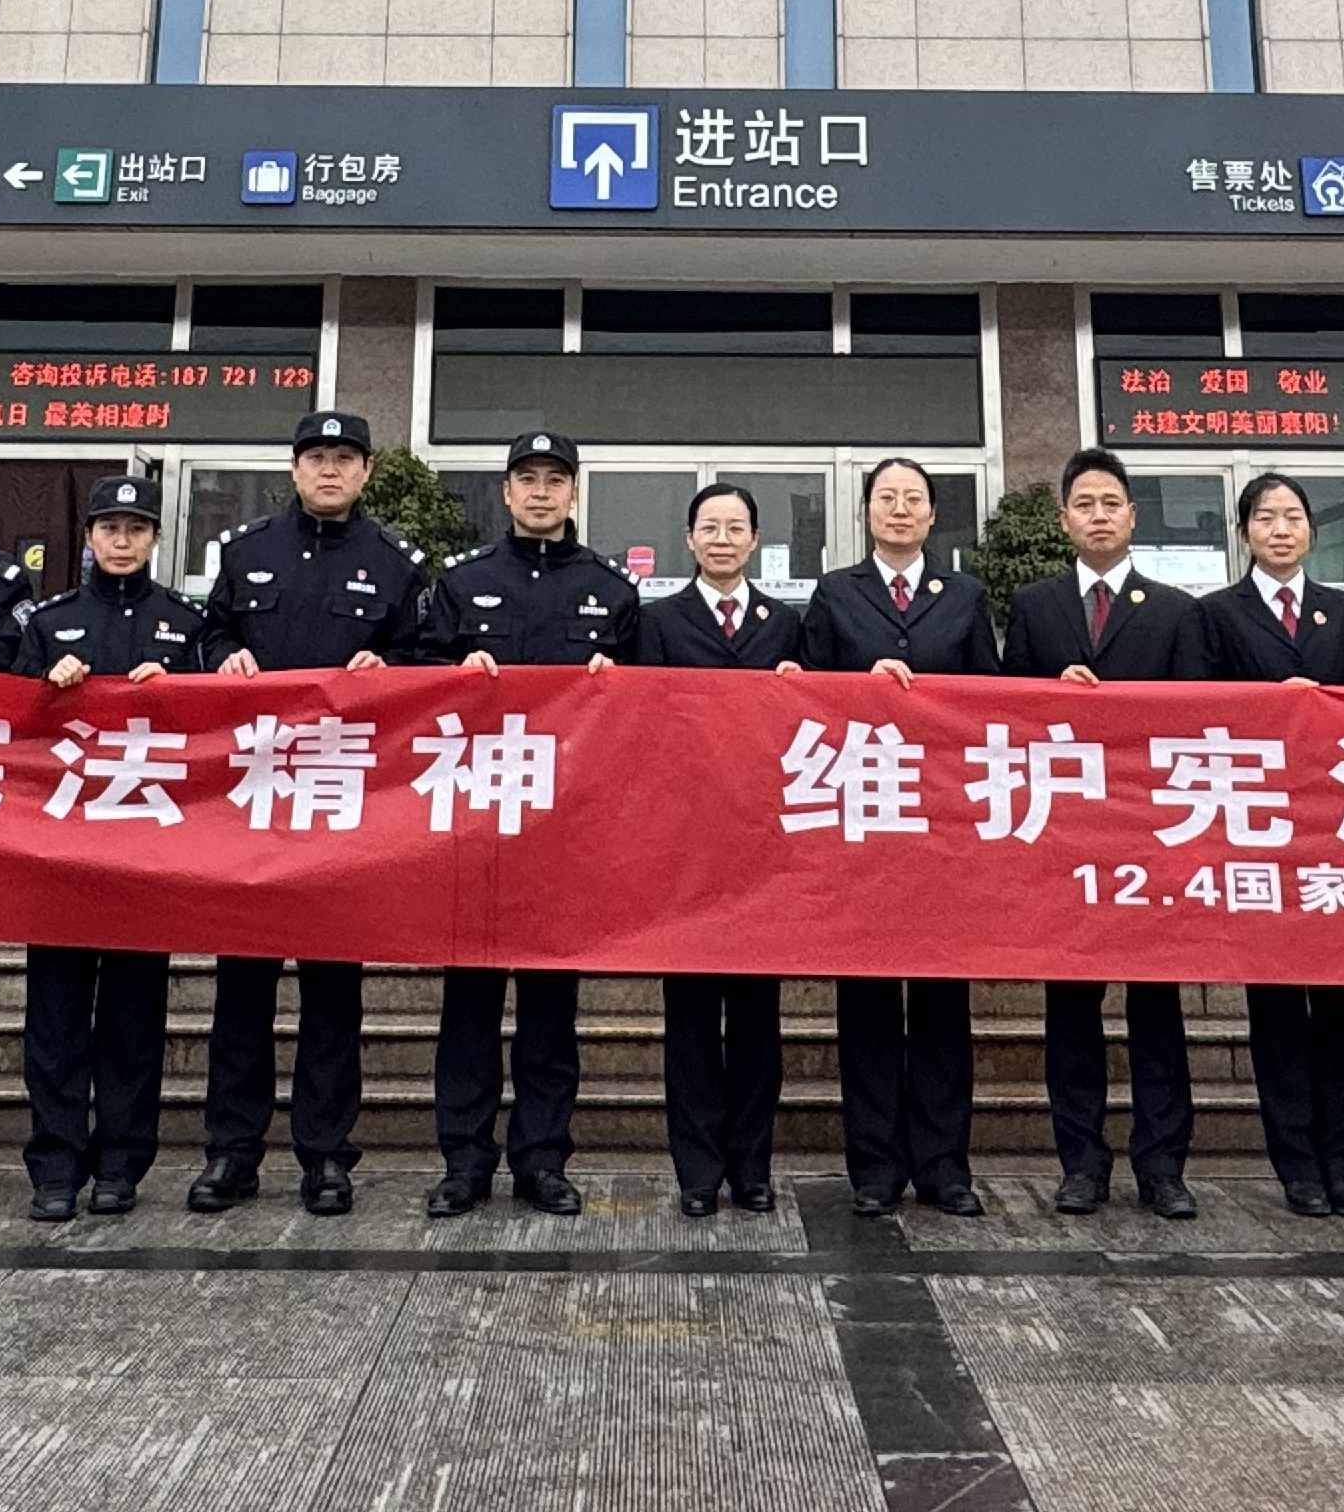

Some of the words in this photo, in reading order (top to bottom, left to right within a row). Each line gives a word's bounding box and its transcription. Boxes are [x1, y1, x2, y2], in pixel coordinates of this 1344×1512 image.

[674, 107, 870, 167] 进站口
[117, 151, 207, 183] 出站口
[303, 152, 402, 184] 行包房
[1185, 157, 1294, 193] 售票处
[116, 186, 150, 203] Exit
[302, 186, 378, 205] Baggage
[672, 175, 839, 209] Entrance
[1229, 194, 1296, 213] Tickets
[273, 367, 313, 388] 123
[1121, 369, 1171, 394] 法治
[1199, 369, 1249, 394] 爱国
[1278, 369, 1328, 395] 敬业
